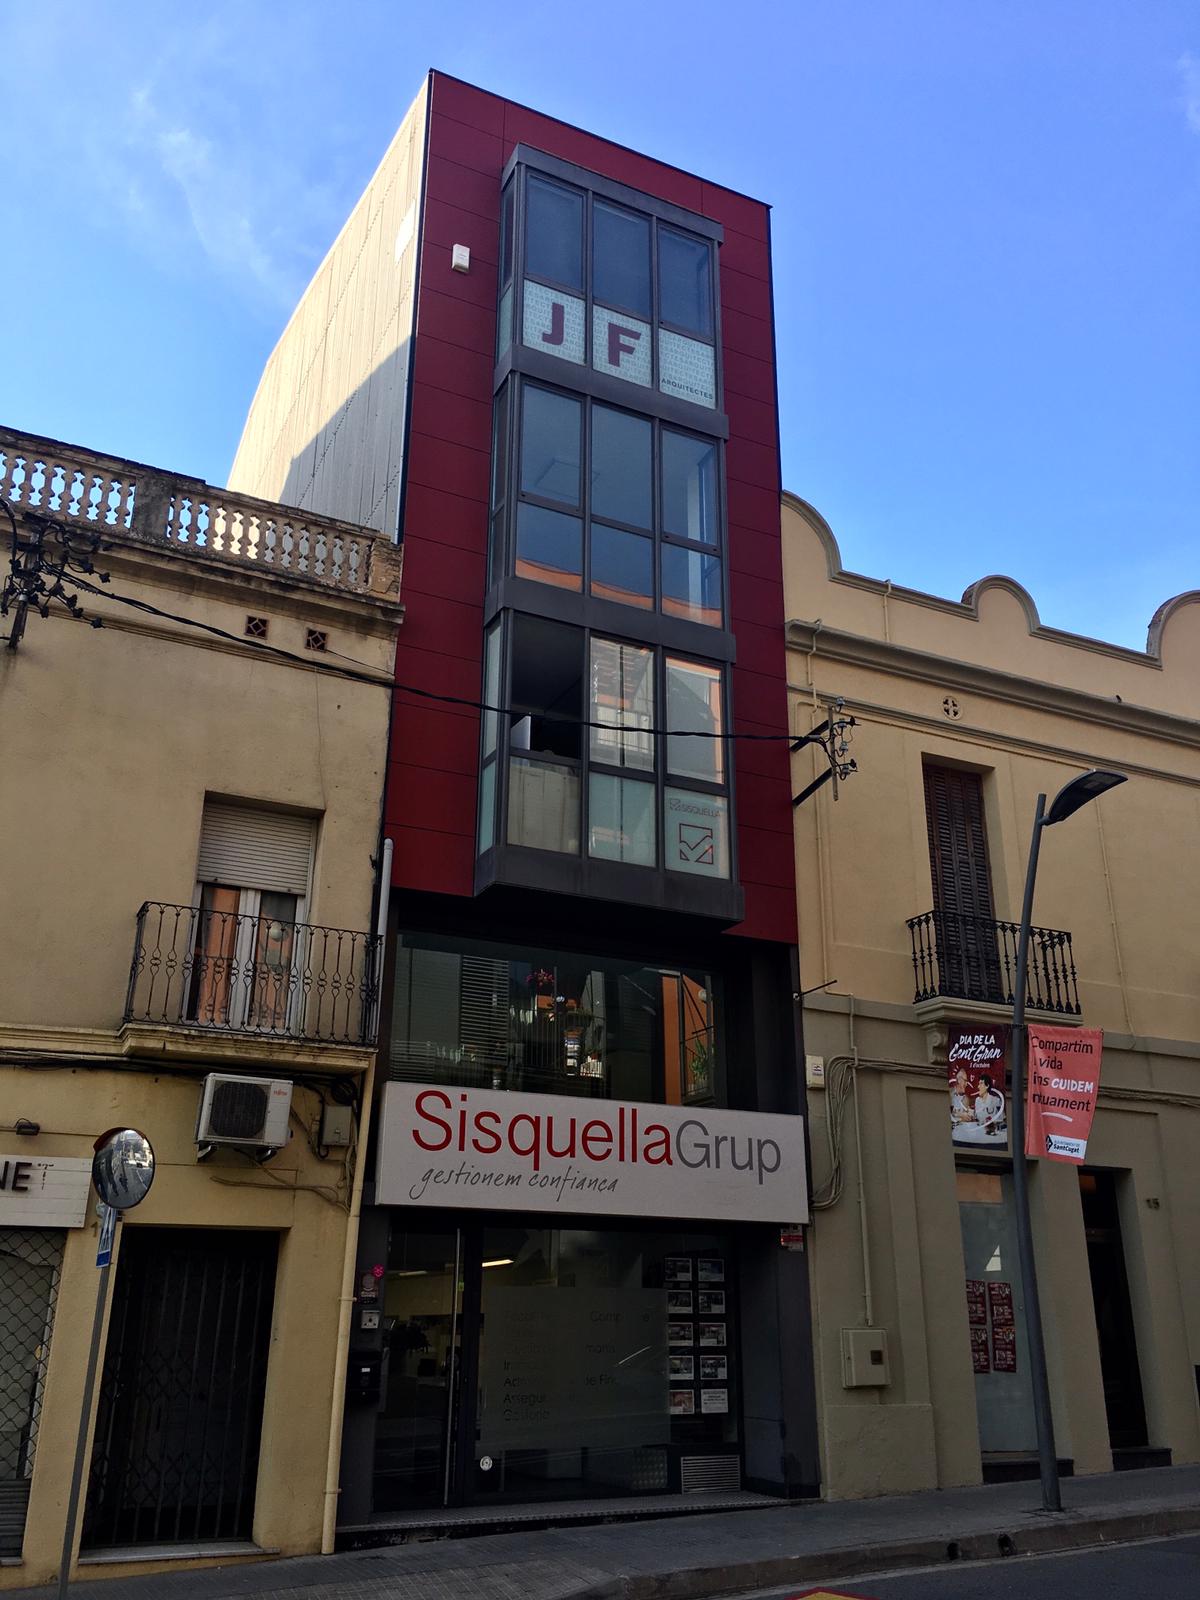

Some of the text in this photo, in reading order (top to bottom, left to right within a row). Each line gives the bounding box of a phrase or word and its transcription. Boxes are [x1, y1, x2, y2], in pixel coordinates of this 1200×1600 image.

[542, 302, 565, 345] J
[607, 322, 642, 367] F
[661, 377, 714, 400] ARQUITECTES
[959, 1034, 995, 1045] DIA DE LA
[949, 1043, 1003, 1062] Gent Gran
[1039, 1055, 1063, 1070] vida
[1051, 1078, 1094, 1093] CUIDEM
[408, 1161, 521, 1201] gestionem
